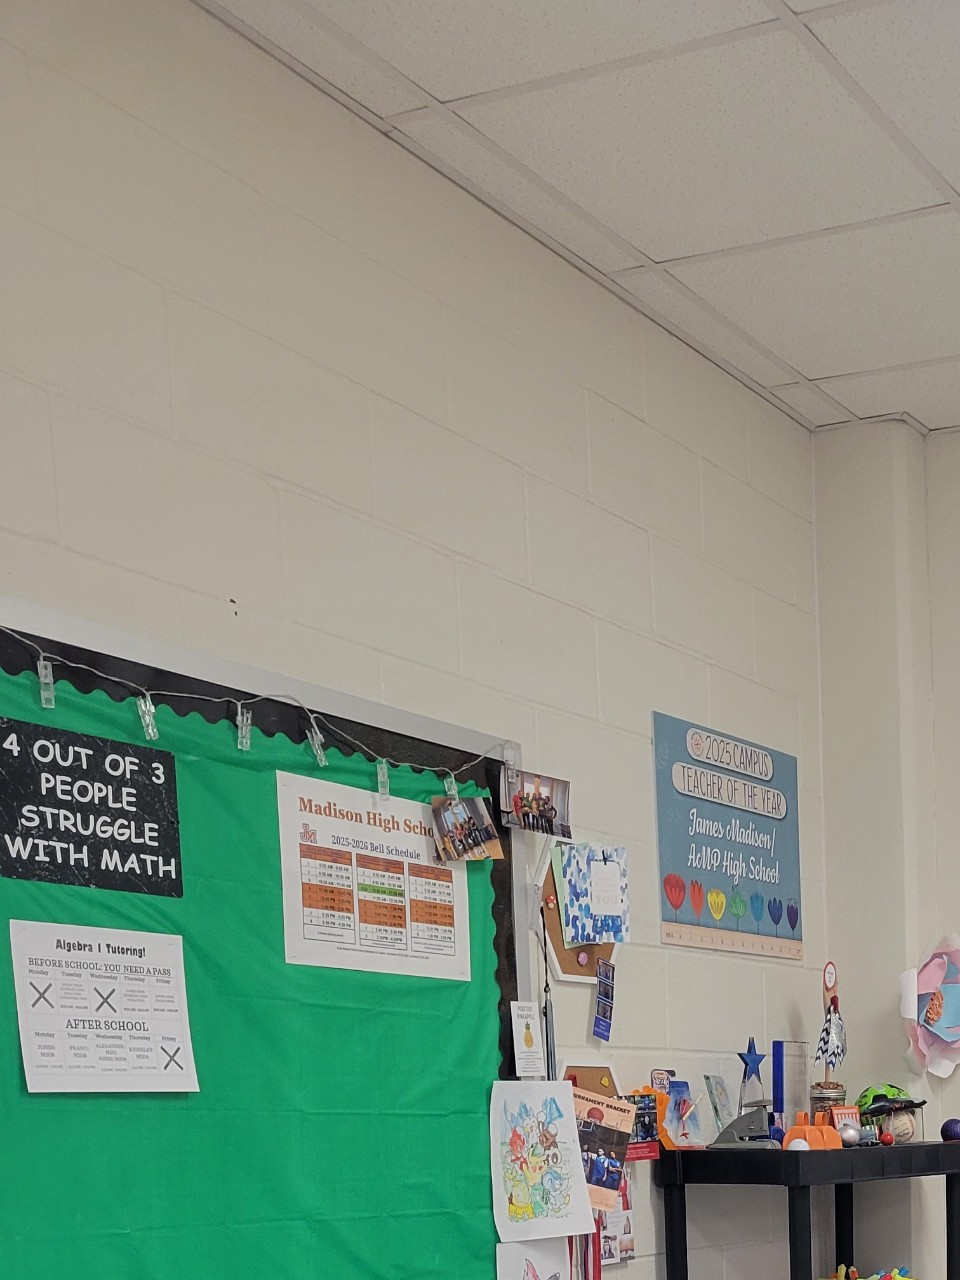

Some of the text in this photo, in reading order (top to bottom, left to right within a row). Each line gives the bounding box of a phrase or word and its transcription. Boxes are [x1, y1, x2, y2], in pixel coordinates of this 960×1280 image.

[3, 733, 165, 784] 4 OUT OF 3
[705, 735, 769, 777] 2025 CAMPUS
[41, 772, 137, 811] PEOPLE
[680, 765, 782, 815] TEACHER OF THE YEAR
[20, 805, 159, 847] STRUGGLE
[298, 797, 434, 838] Madison High Scho
[688, 808, 725, 838] James
[4, 834, 176, 879] WITH MATH
[331, 835, 421, 860] 2025-2026 Bell Schedule
[722, 850, 747, 885] High
[749, 857, 780, 884] School
[55, 938, 93, 954] Algebra
[106, 943, 146, 959] Tutoring!
[28, 957, 171, 977] BEFORE SCHOOL: YOU NEED A PASS
[28, 968, 49, 977] Monday
[61, 970, 82, 979] Tuesday
[90, 972, 118, 981] Wednesday
[124, 975, 146, 983] Thursday
[34, 1031, 55, 1039] Monday
[67, 1032, 88, 1040] Tuesday
[95, 1033, 123, 1041] Wednesday
[65, 1018, 149, 1032] AFTER SCHOOL
[605, 1102, 632, 1115] BRACKET
